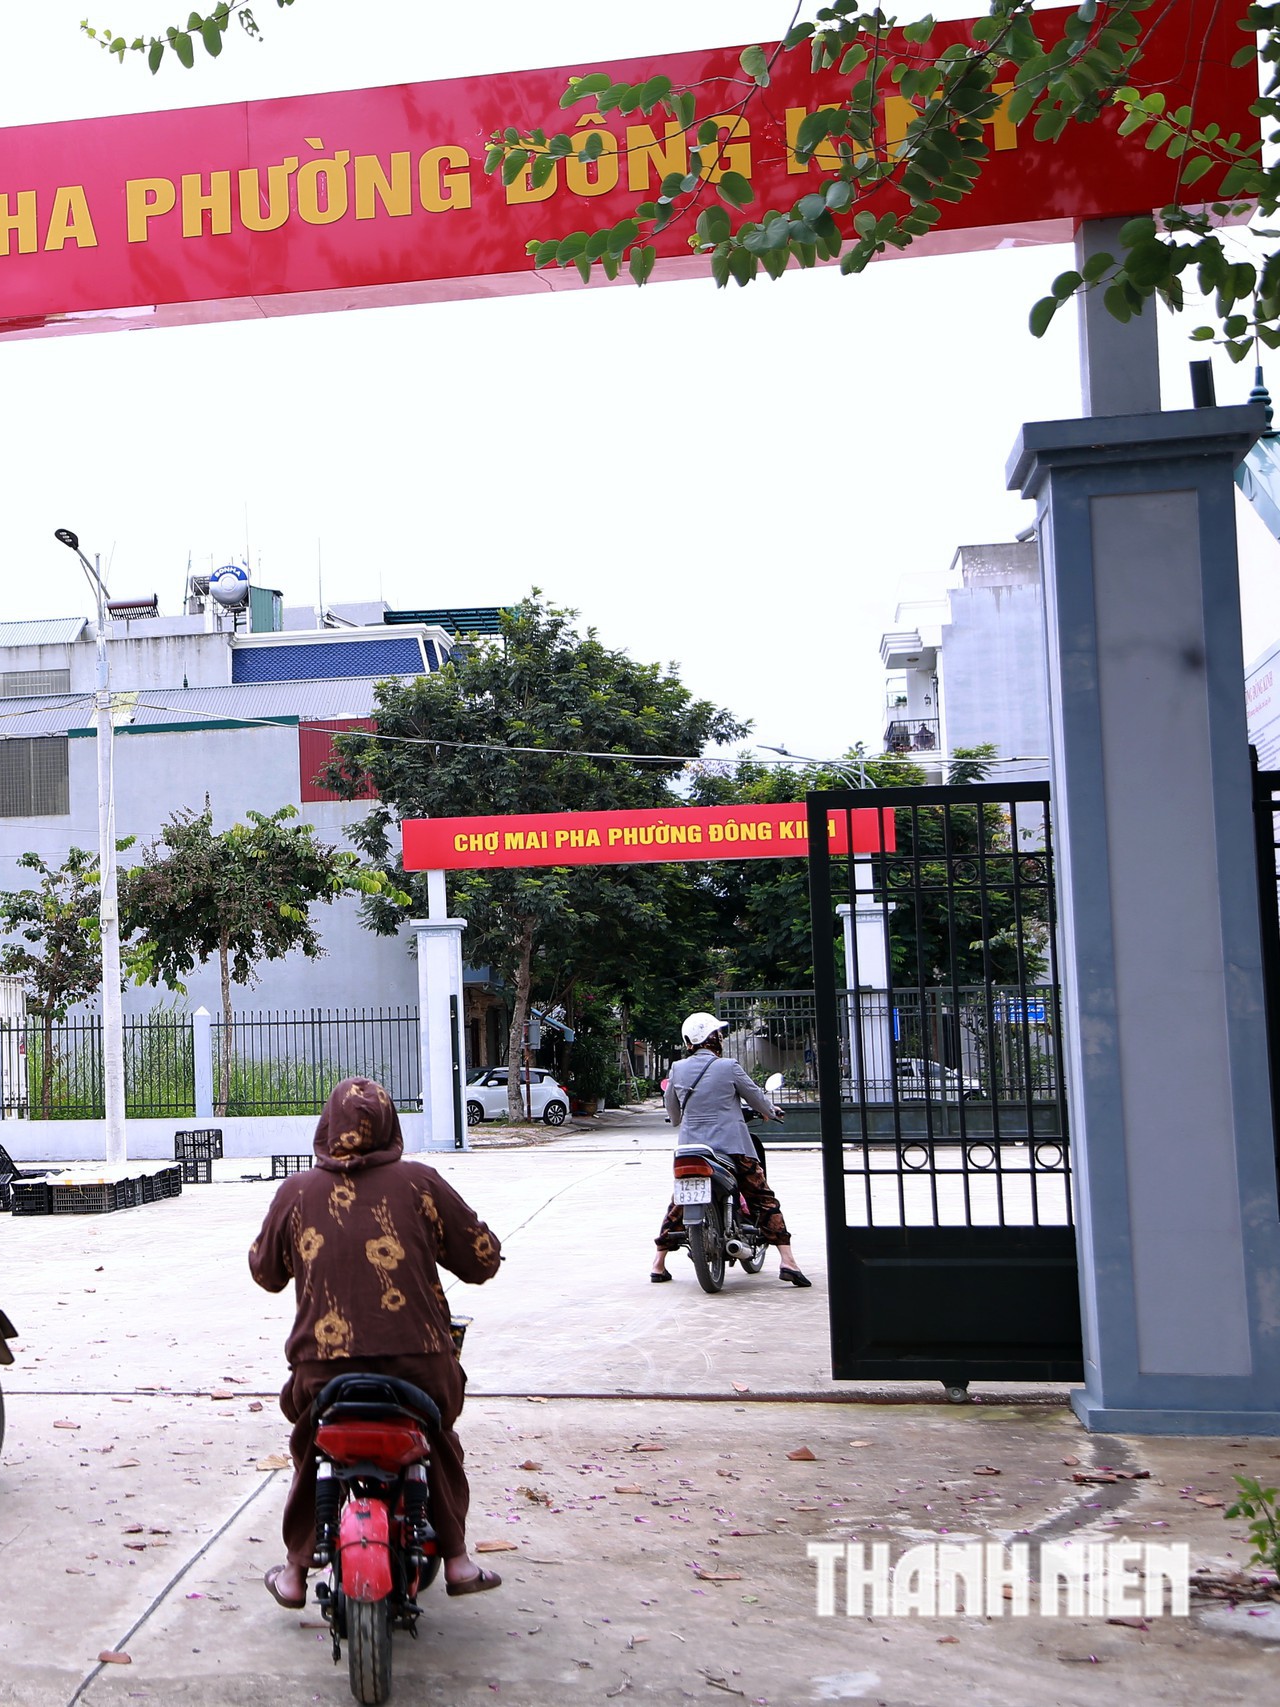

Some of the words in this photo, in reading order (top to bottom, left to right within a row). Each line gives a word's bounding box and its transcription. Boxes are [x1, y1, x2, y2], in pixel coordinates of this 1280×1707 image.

[126, 137, 471, 243] PHƯỜNG
[454, 831, 499, 855] CHỢ
[504, 830, 548, 850] MAI
[555, 829, 601, 848] PHA
[608, 820, 702, 846] PHƯỜNG
[708, 819, 772, 842] ĐÔNG
[679, 1191, 706, 1203] 8327
[680, 1179, 706, 1191] 12-F3
